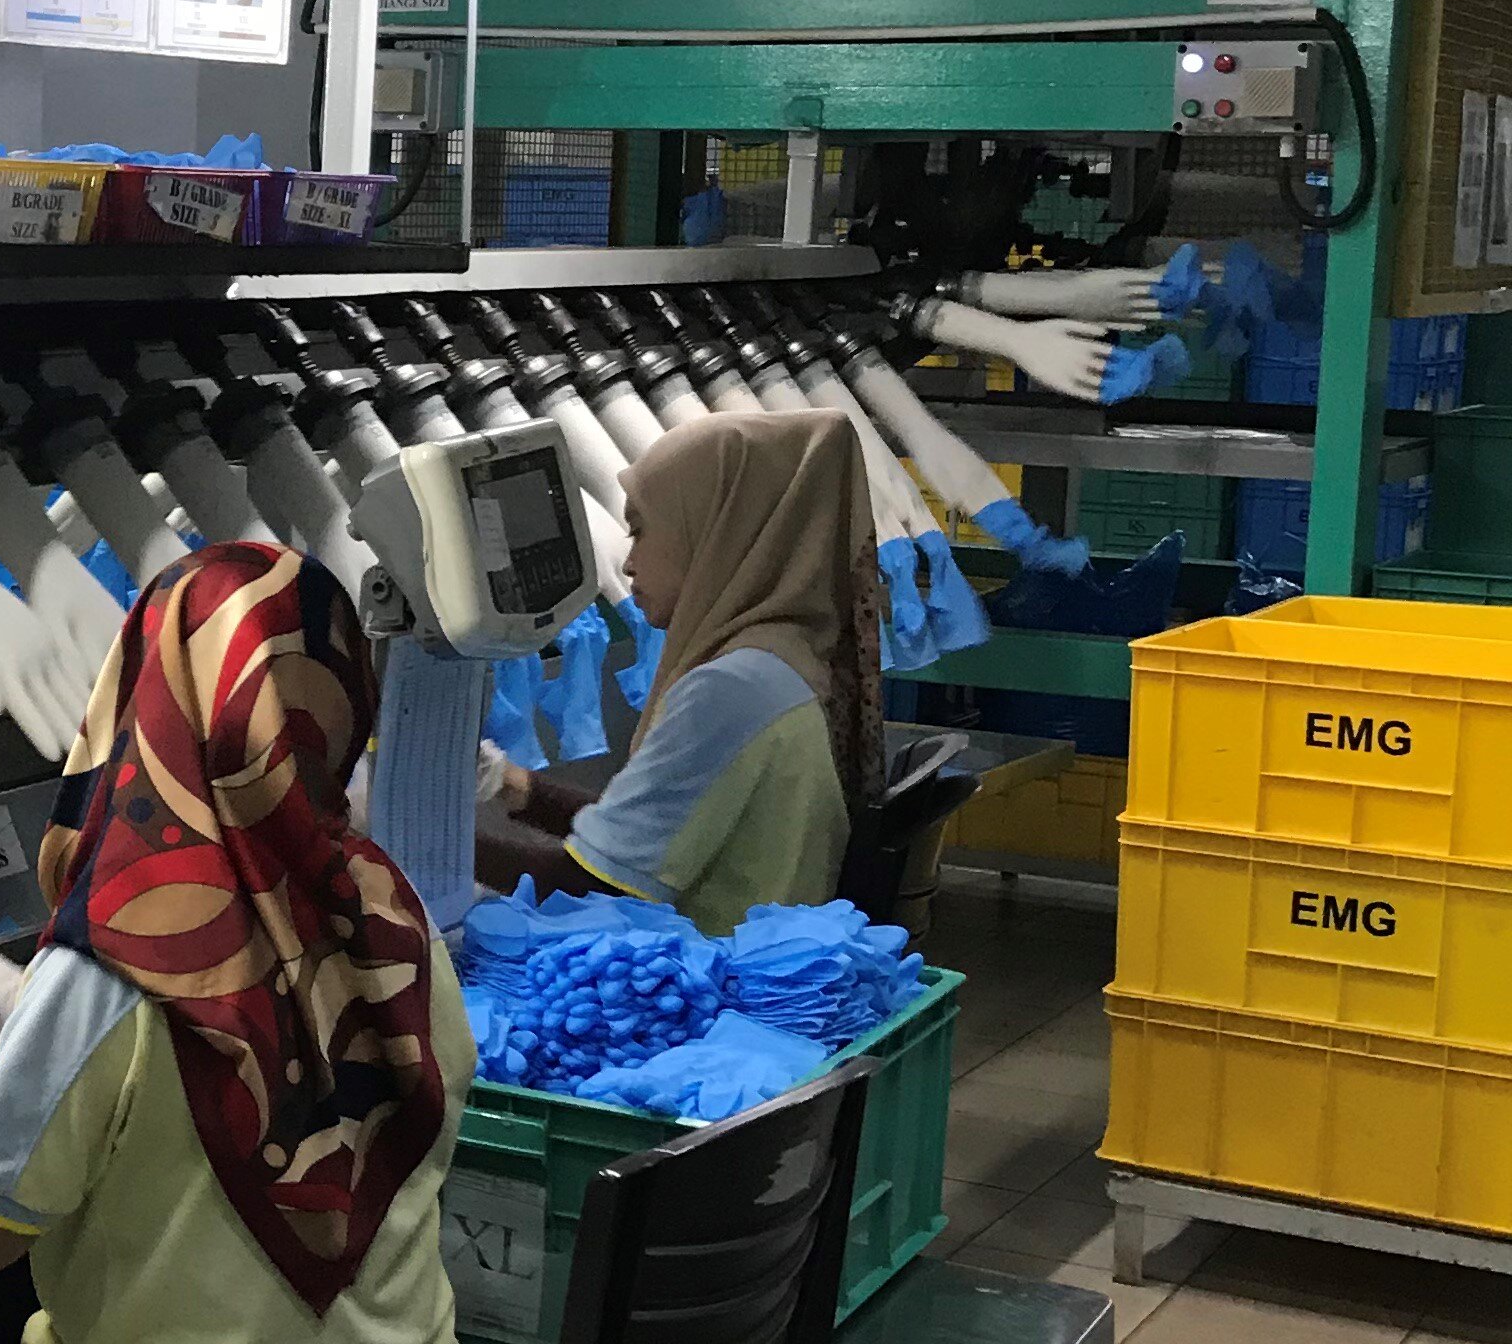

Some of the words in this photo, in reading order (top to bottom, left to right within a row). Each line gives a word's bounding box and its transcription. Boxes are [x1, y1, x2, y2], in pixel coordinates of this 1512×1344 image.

[324, 186, 360, 208] GRADE
[169, 202, 201, 226] SIZE
[300, 203, 326, 224] SIZE
[10, 221, 39, 238] SIZE
[1305, 712, 1412, 756] EMG
[1291, 891, 1396, 937] EMG
[450, 1212, 536, 1281] XL
